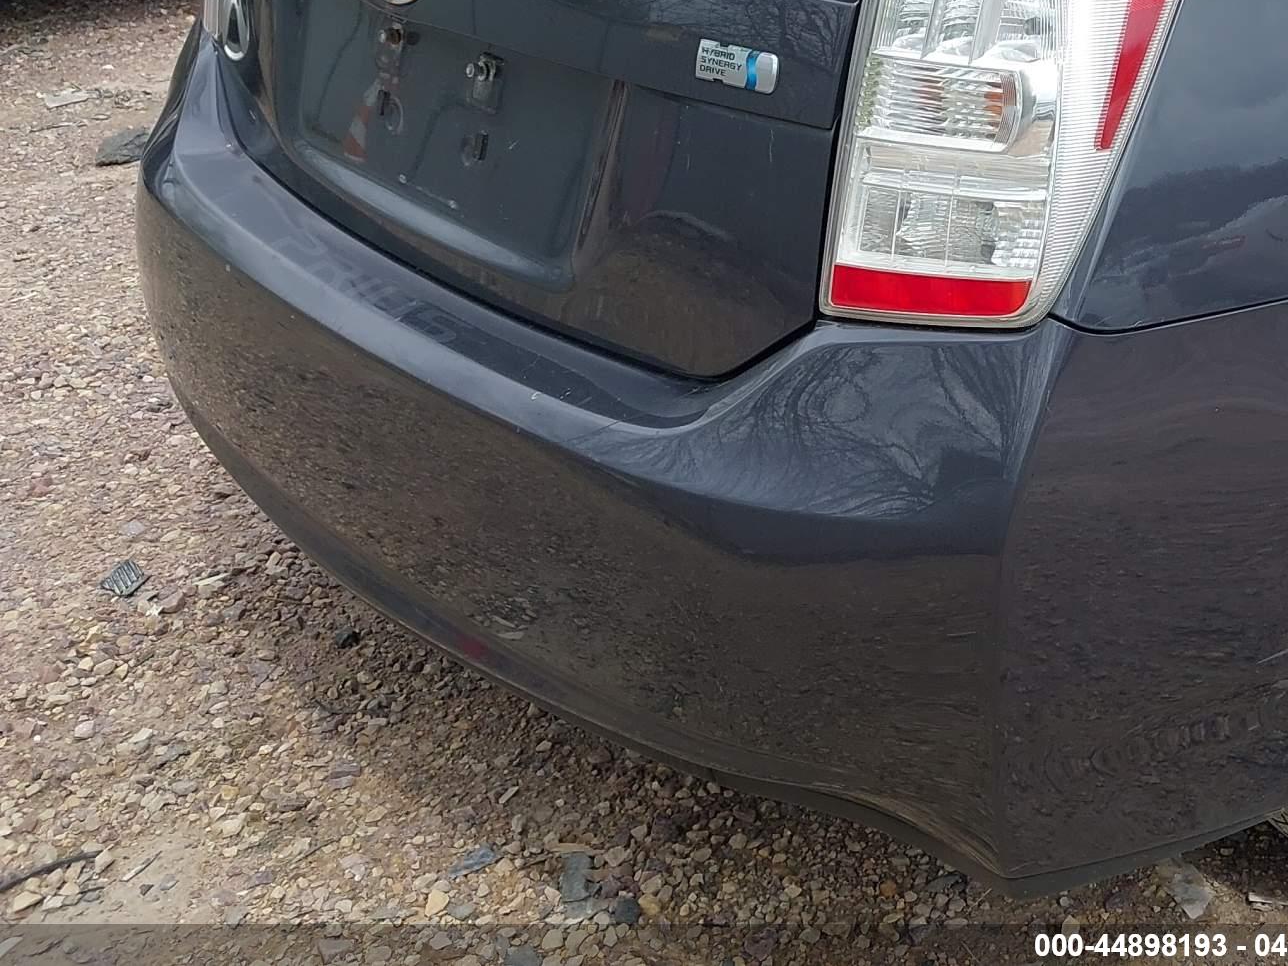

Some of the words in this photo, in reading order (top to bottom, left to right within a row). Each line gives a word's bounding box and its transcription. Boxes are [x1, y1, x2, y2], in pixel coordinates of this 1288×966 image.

[701, 46, 736, 61] HYBRID
[699, 64, 727, 77] DRIVE
[700, 55, 743, 71] SYNERGY
